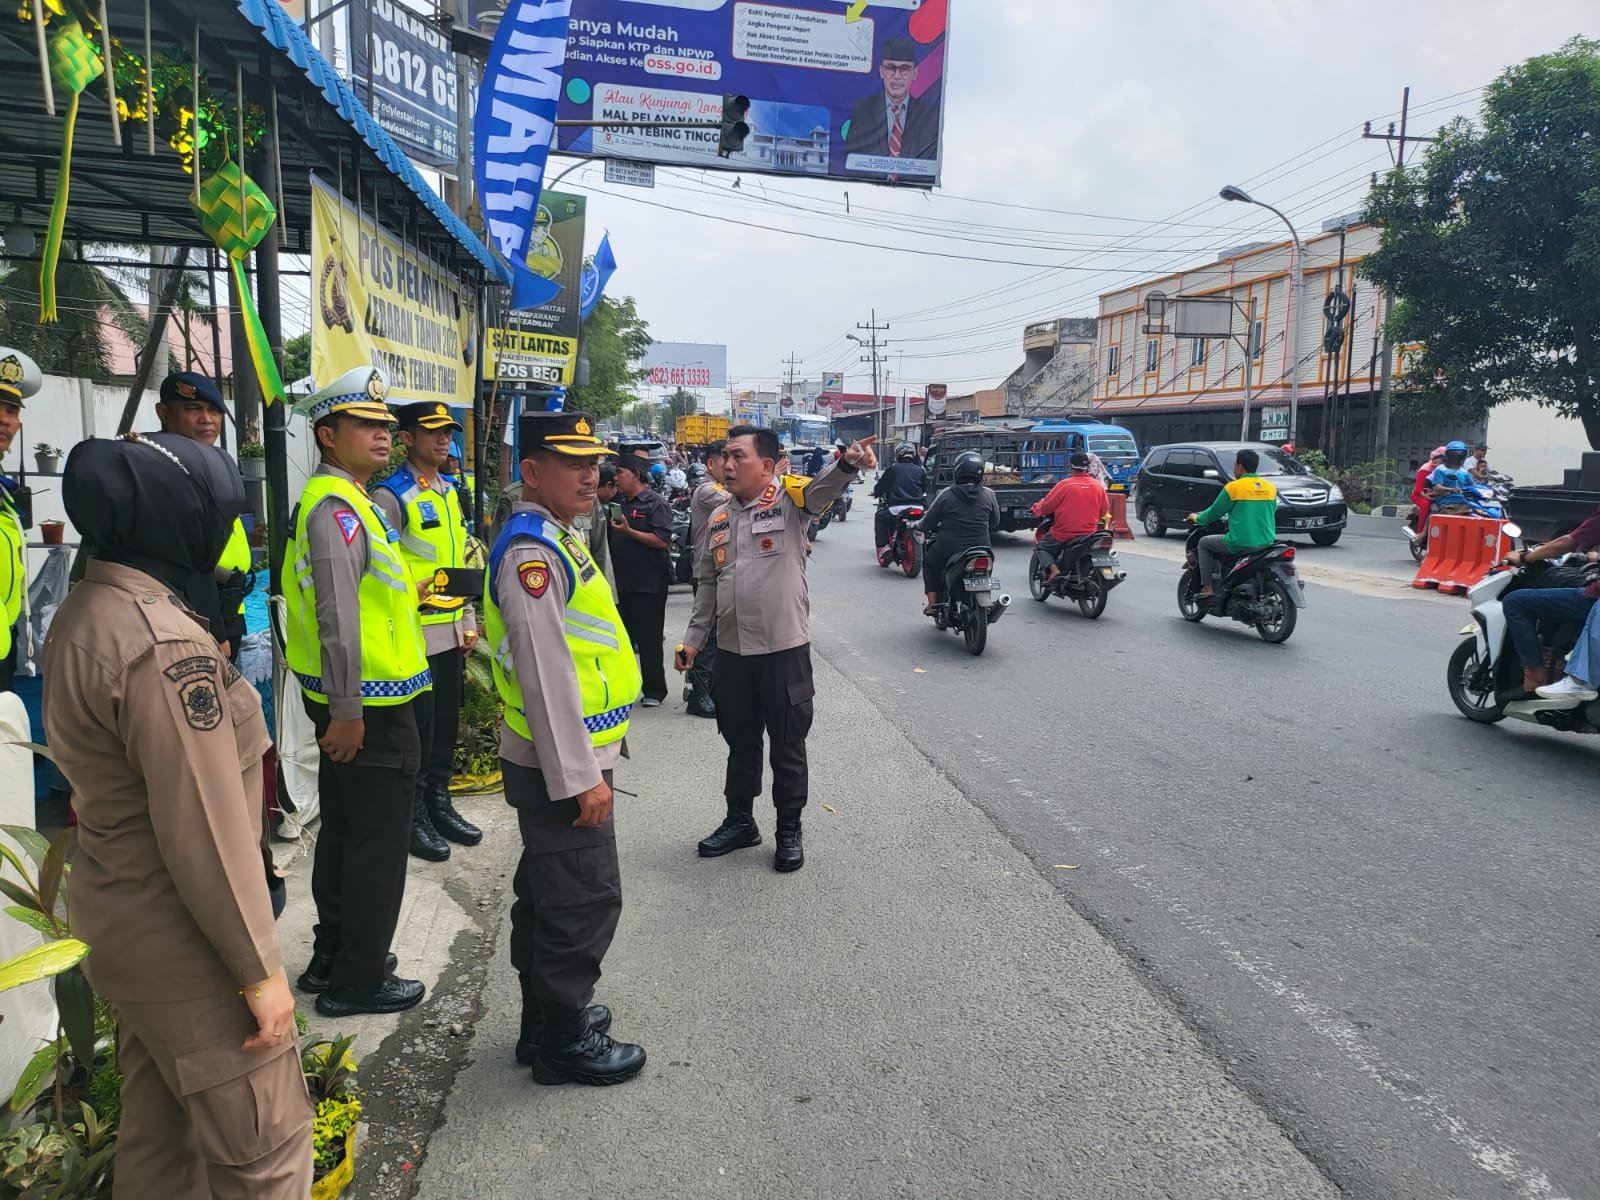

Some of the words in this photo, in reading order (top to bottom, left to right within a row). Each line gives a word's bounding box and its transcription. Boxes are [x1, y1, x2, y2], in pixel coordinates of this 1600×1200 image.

[747, 20, 765, 29] Angka
[748, 9, 763, 17] Bukti
[764, 10, 791, 21] Registrasi
[795, 14, 828, 24] Pendaftaran
[569, 19, 611, 35] anya
[617, 21, 678, 42] Mudah
[759, 33, 775, 41] Akses
[578, 36, 625, 50] Siapkan
[628, 42, 650, 52] KTP
[653, 44, 675, 56] dan
[678, 47, 714, 60] NPWP
[746, 43, 779, 53] Pendaftaran
[815, 51, 833, 60] Pelaku
[366, 32, 427, 97] 0812
[565, 50, 593, 62] udian
[596, 54, 627, 66] Akses
[630, 57, 644, 67] Ke
[647, 58, 716, 75] oss.go.id.
[603, 89, 634, 105] Atau
[639, 92, 692, 114] Kunjungi
[697, 97, 723, 117] Lang
[381, 103, 430, 130] odylestari.com
[602, 109, 628, 121] MAL
[602, 126, 634, 136] KOTA
[640, 127, 681, 139] TEBING
[684, 130, 720, 143] TINGG
[361, 231, 394, 290] POS
[364, 292, 413, 348] LEBARAN
[414, 314, 442, 357] TAHUN
[442, 327, 458, 360] 2023
[492, 333, 517, 350] SAT
[521, 336, 570, 355] LANTAS
[370, 348, 407, 390] POLRES
[409, 357, 436, 392] TEBING
[437, 365, 457, 395] TINGGI
[545, 357, 567, 366] TINGGI
[498, 363, 528, 378] POS
[532, 365, 559, 382] BEO
[687, 368, 710, 386] 33333
[754, 507, 782, 521] POLRI
